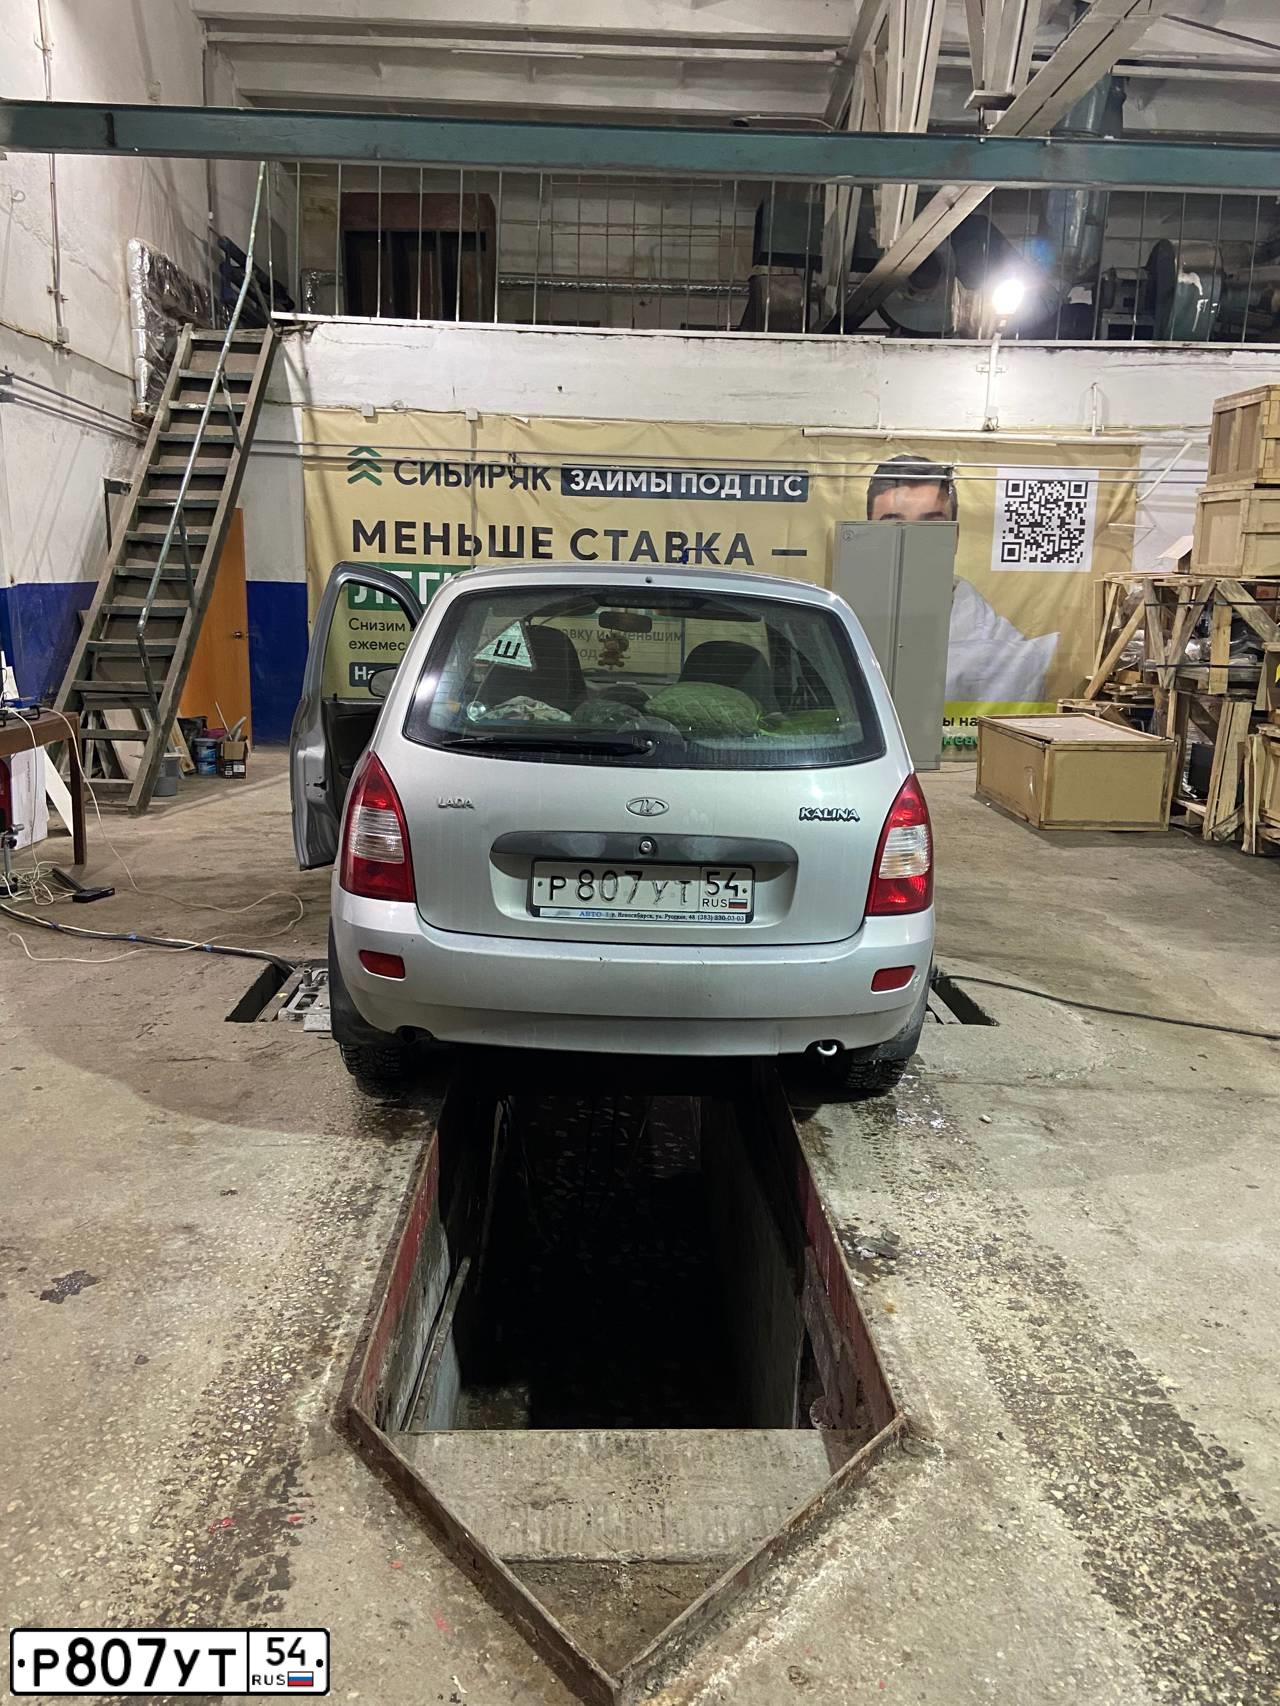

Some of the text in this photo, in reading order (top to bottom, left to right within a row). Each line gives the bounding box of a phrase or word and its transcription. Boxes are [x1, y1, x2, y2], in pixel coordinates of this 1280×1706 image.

[393, 457, 552, 491] СИБИРЯК
[570, 466, 802, 498] ЗАЙМЫ ПОД ПТС
[352, 519, 553, 559] МЕНЬШЕ
[569, 528, 755, 566] СТАВКА
[348, 617, 406, 632] Снизим
[493, 640, 521, 660] Ш
[799, 807, 860, 822] KALINA
[706, 872, 739, 898] 54
[702, 898, 728, 908] RUS
